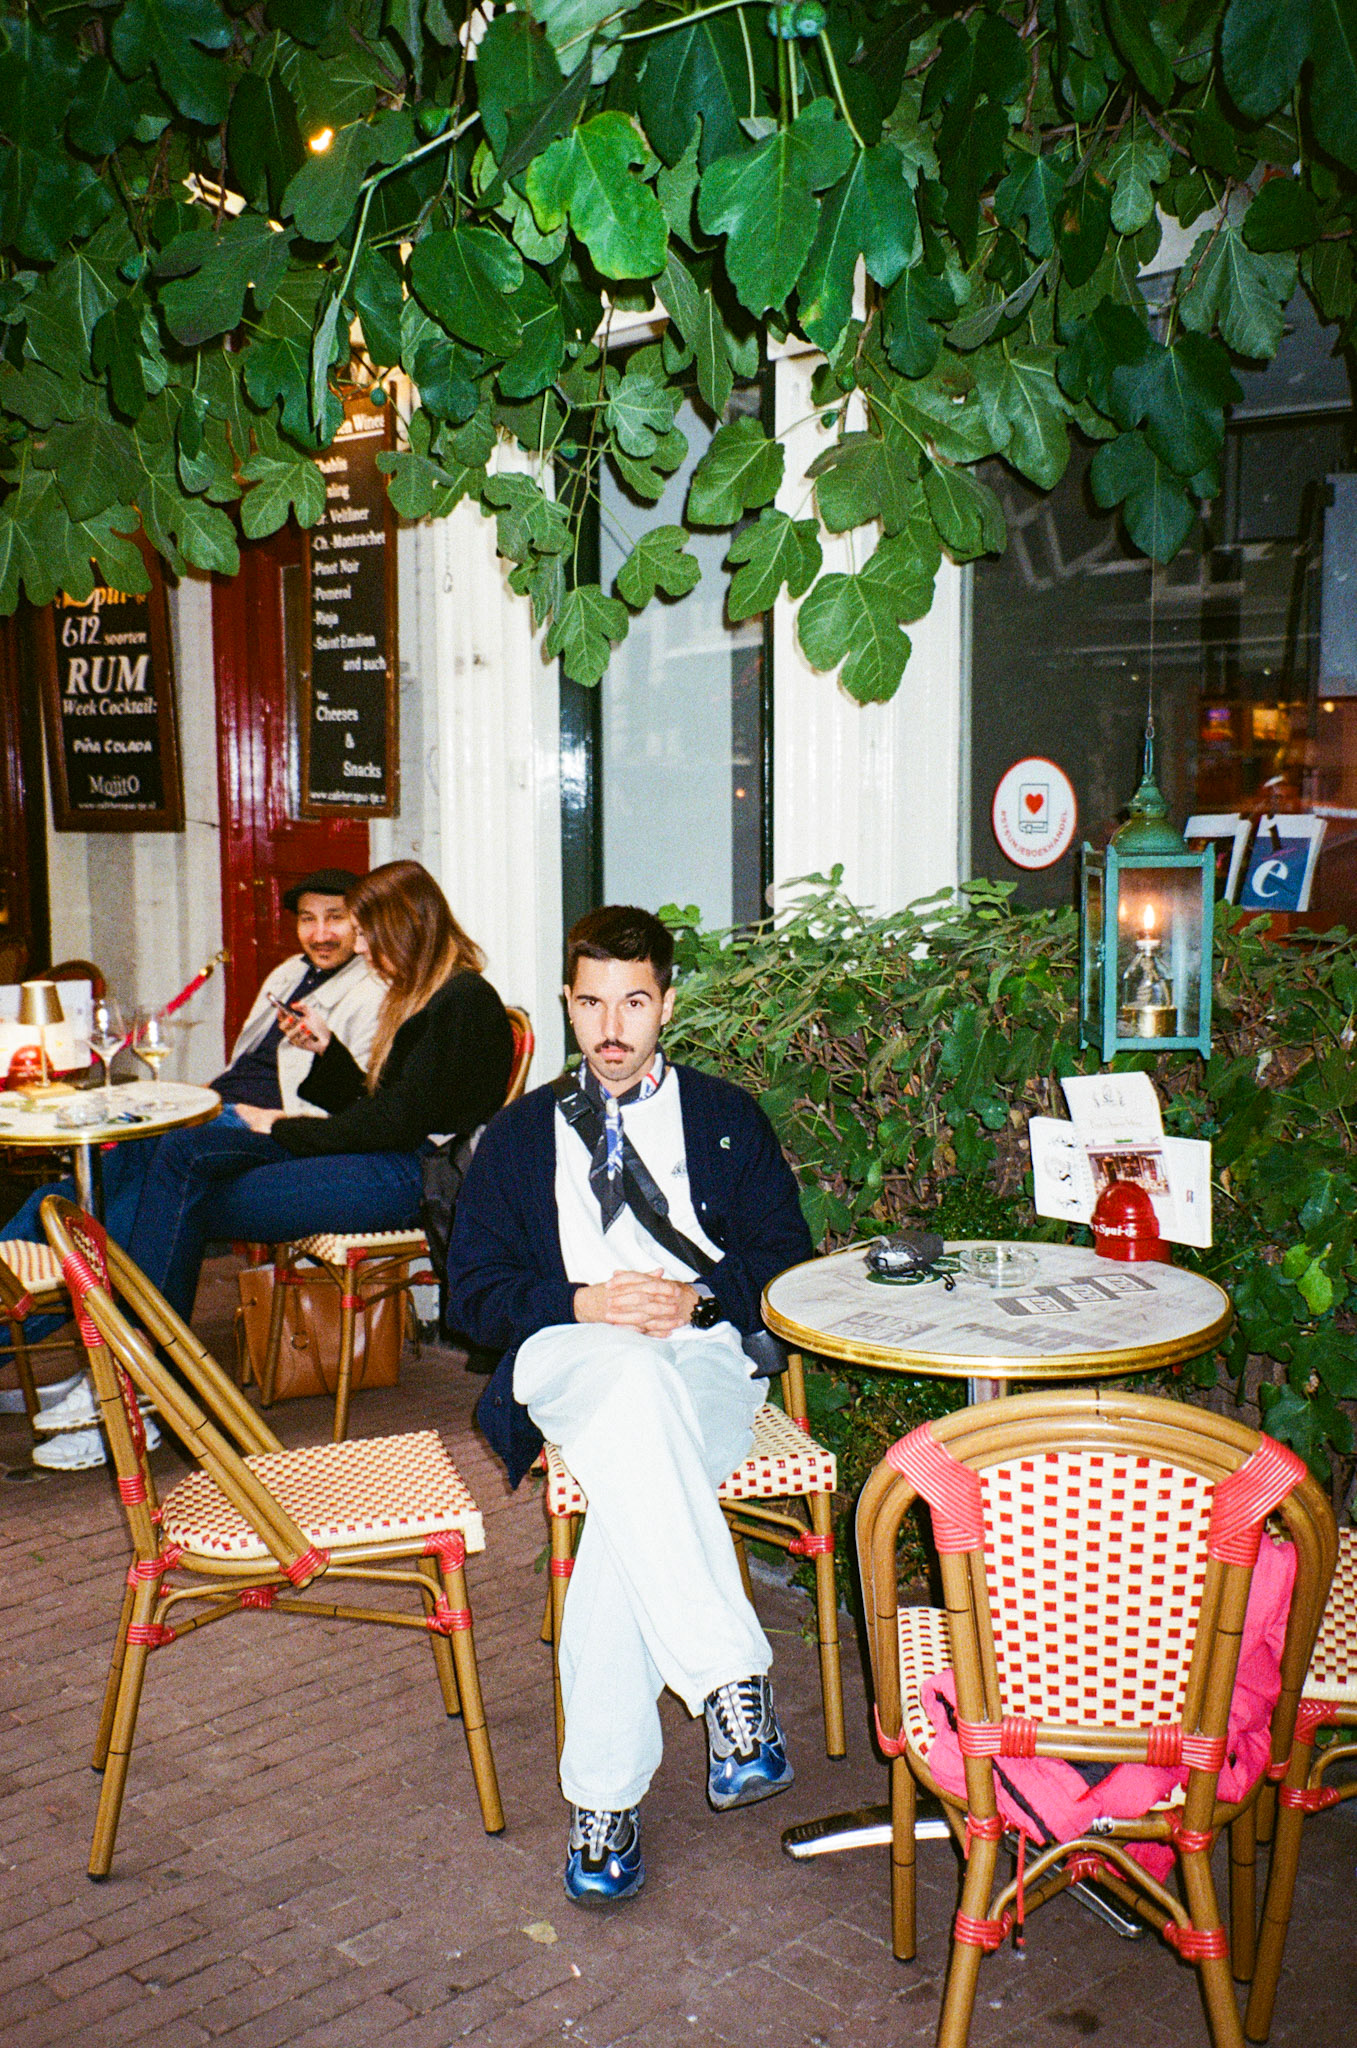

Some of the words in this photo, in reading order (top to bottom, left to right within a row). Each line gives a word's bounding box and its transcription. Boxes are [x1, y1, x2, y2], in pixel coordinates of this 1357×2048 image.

[313, 561, 338, 576] Pinot
[340, 558, 360, 574] Noir
[313, 584, 352, 601] Pomerol
[103, 632, 147, 646] soorten
[313, 635, 340, 650] Saint
[343, 656, 361, 671] and
[362, 655, 387, 671] such
[66, 654, 150, 695] RUM
[63, 698, 97, 716] Week
[99, 696, 158, 716] Cocktail:
[315, 705, 359, 721] Cheeses
[344, 732, 355, 749] &
[343, 760, 383, 778] Snacks
[1251, 859, 1289, 898] e
